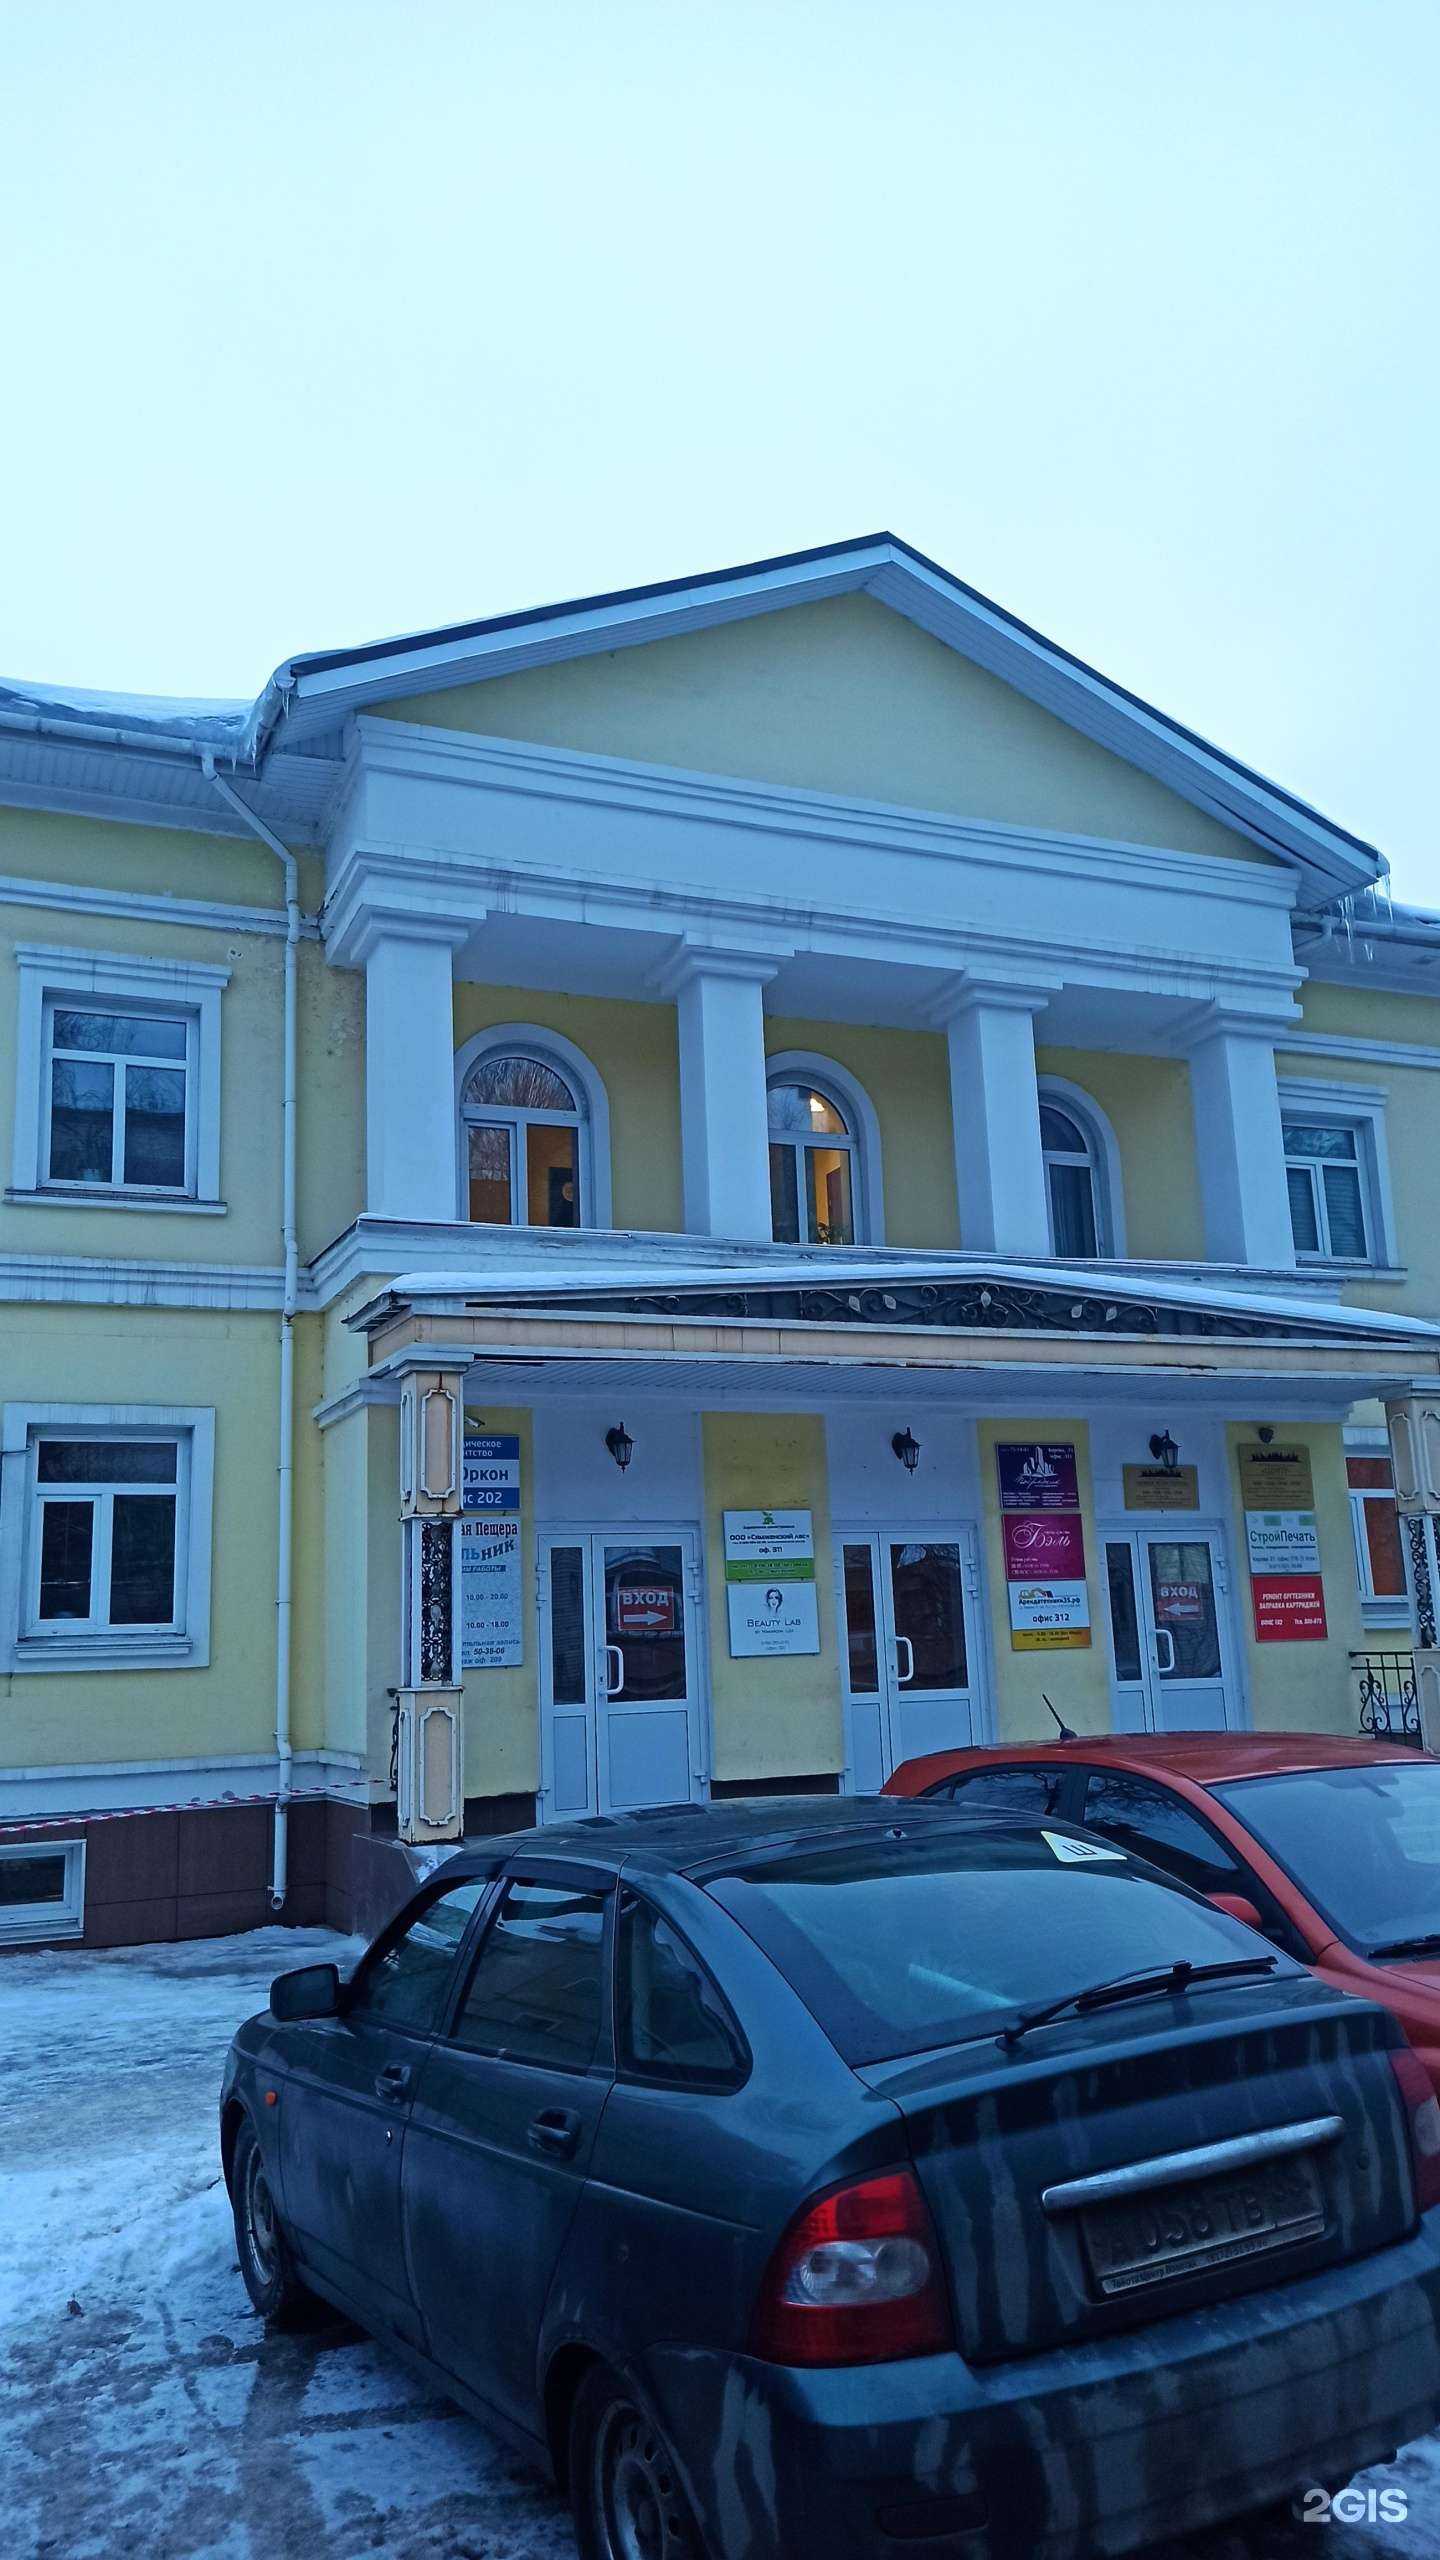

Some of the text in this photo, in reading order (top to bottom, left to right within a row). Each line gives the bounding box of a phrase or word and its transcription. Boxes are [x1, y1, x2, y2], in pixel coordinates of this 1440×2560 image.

[477, 1492, 503, 1504] 202
[476, 1522, 518, 1538] Пещера
[622, 1590, 669, 1607] ВХОД
[1159, 1586, 1198, 1599] ВХОД
[1032, 1613, 1070, 1624] офис 312
